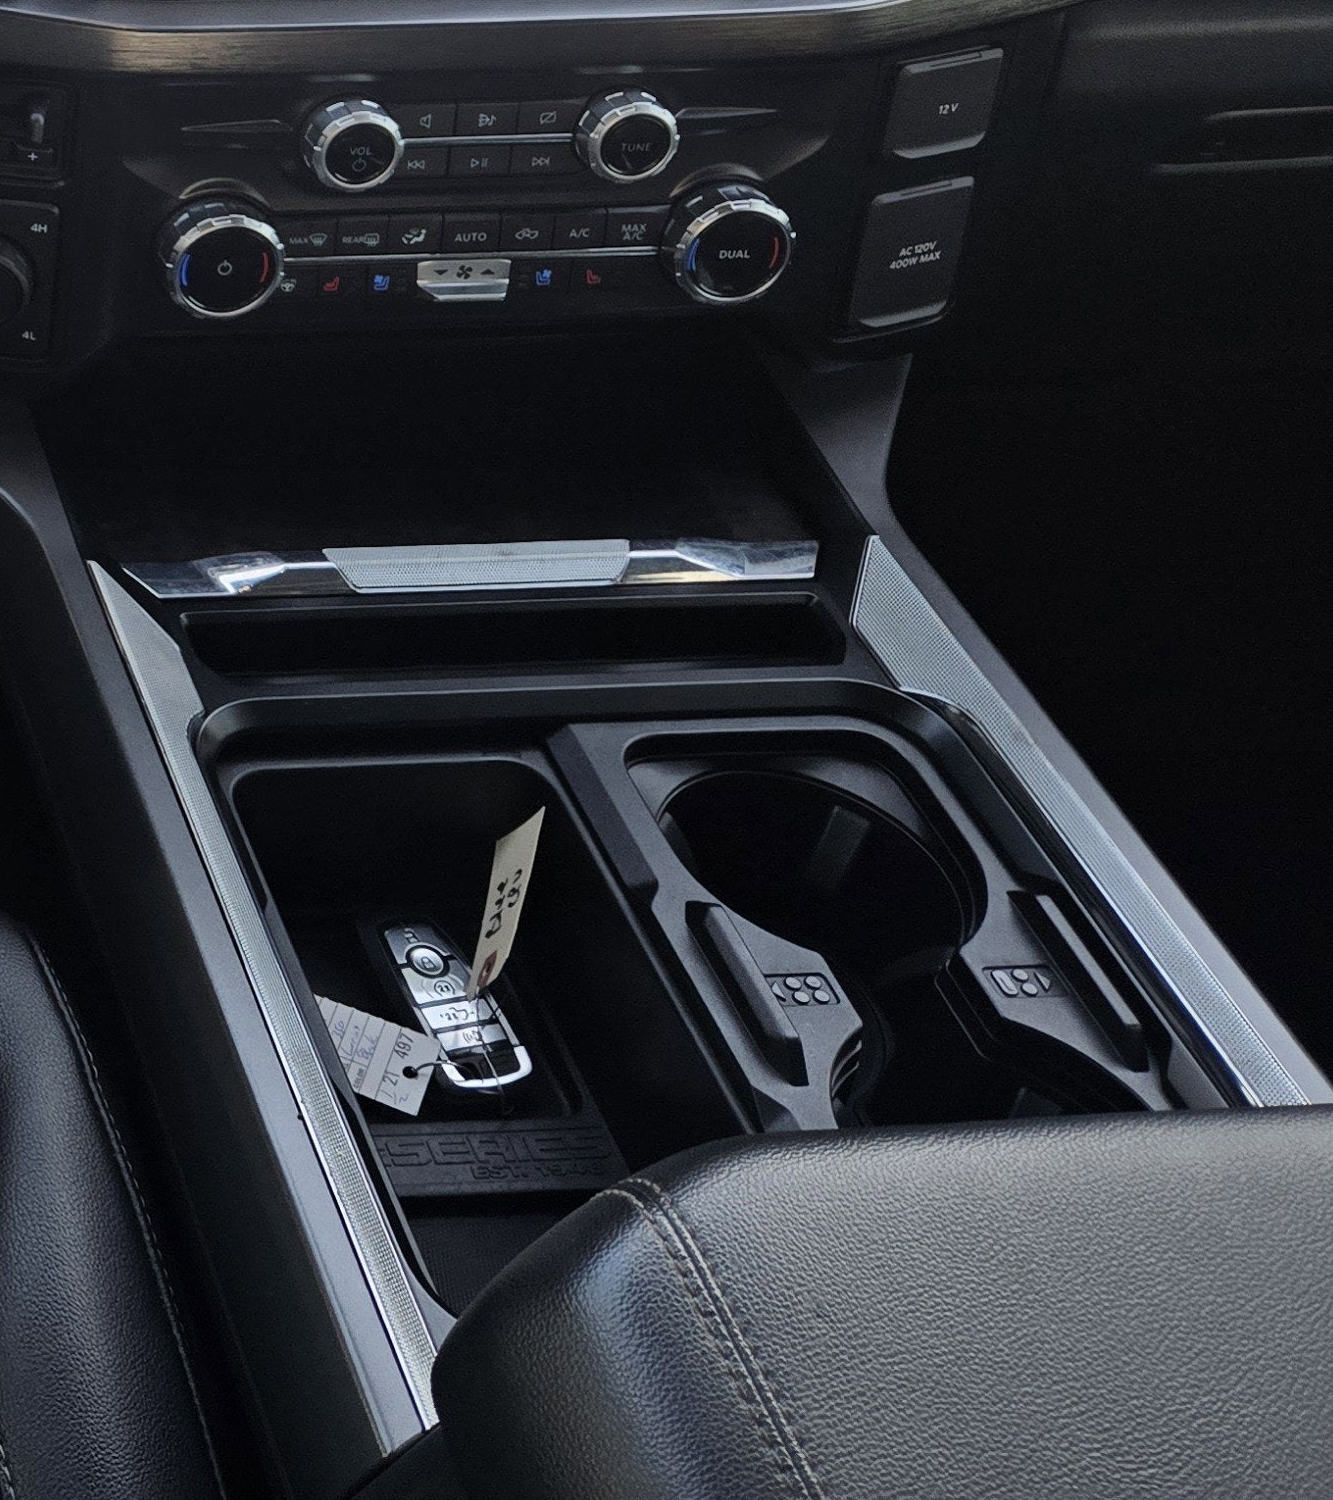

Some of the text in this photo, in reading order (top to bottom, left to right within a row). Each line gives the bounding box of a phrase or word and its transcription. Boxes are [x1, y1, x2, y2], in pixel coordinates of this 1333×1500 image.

[349, 145, 372, 156] VOL
[621, 142, 653, 153] TUNE
[30, 223, 48, 233] 4H
[621, 223, 647, 233] MAX
[454, 232, 487, 242] AUTO
[569, 228, 590, 239] A/C
[623, 231, 644, 241] A/C
[719, 249, 750, 259] DUAL
[899, 241, 937, 257] AC 120V
[889, 251, 941, 270] 400W MAX
[22, 331, 36, 341] 4L
[396, 1033, 414, 1059] 497
